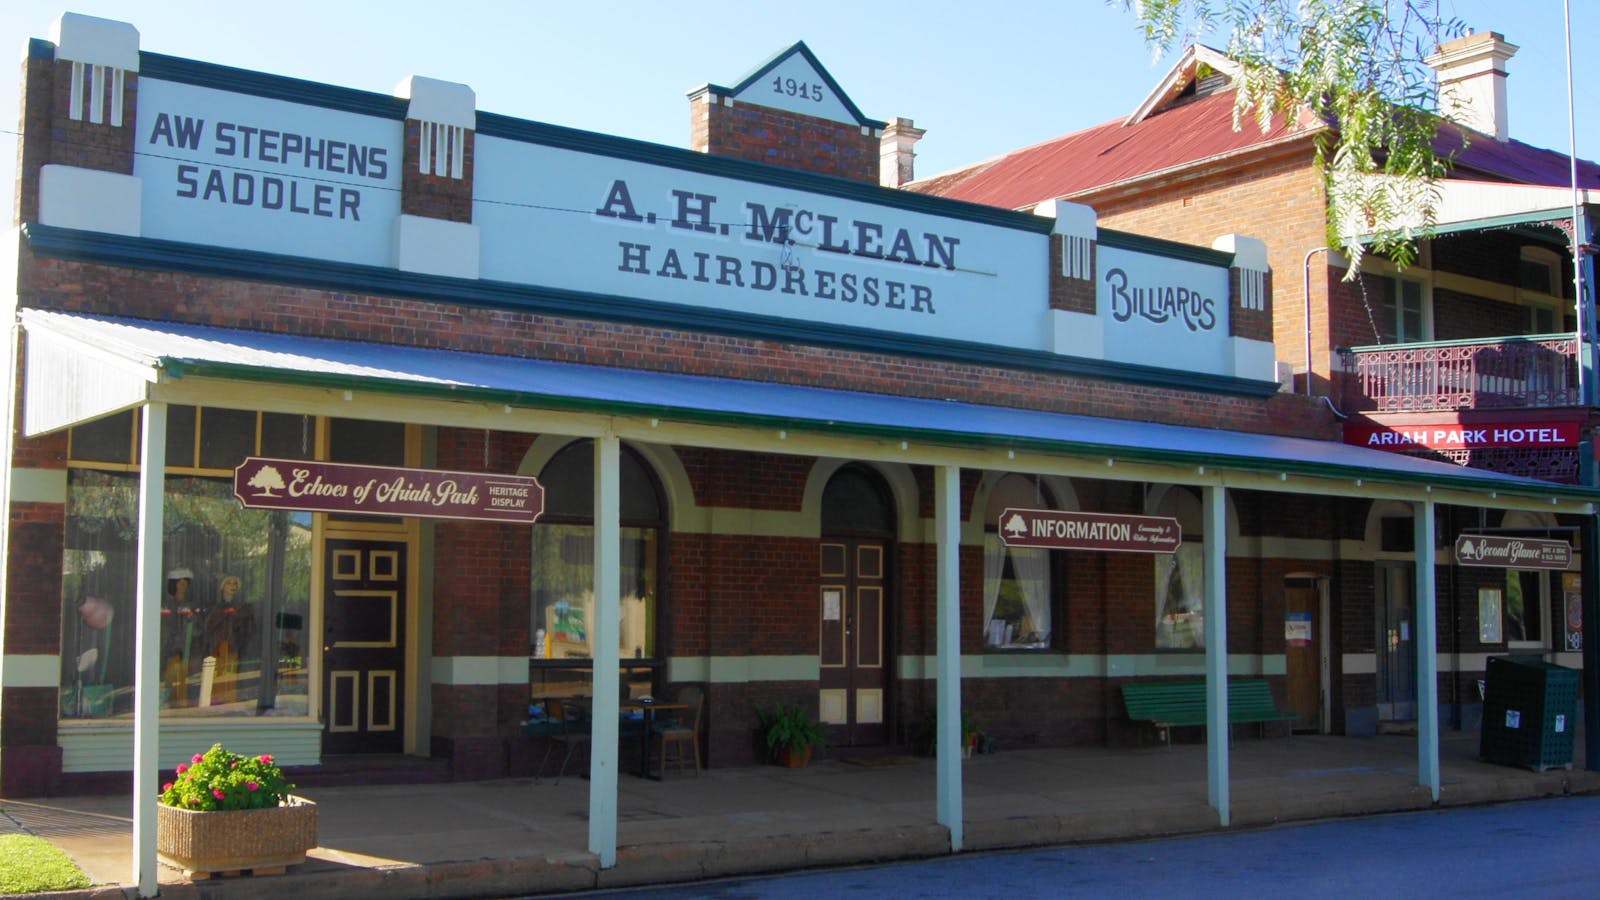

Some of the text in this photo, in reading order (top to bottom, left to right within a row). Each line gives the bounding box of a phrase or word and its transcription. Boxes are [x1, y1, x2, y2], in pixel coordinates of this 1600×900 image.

[773, 76, 823, 102] 1915
[149, 112, 388, 180] AW STEPHENS
[176, 164, 361, 222] SADDLER
[617, 241, 937, 314] HAIRDRESSER
[1105, 267, 1216, 332] BILLIARDS
[1367, 427, 1566, 446] ARIAH PARK HOTEL
[288, 468, 480, 506] Echoes of Ariah Park
[489, 486, 529, 498] HERITAGE
[491, 497, 526, 508] DISPLAY
[1031, 518, 1131, 542] INFORMATION
[1475, 538, 1540, 564] Second Glance
